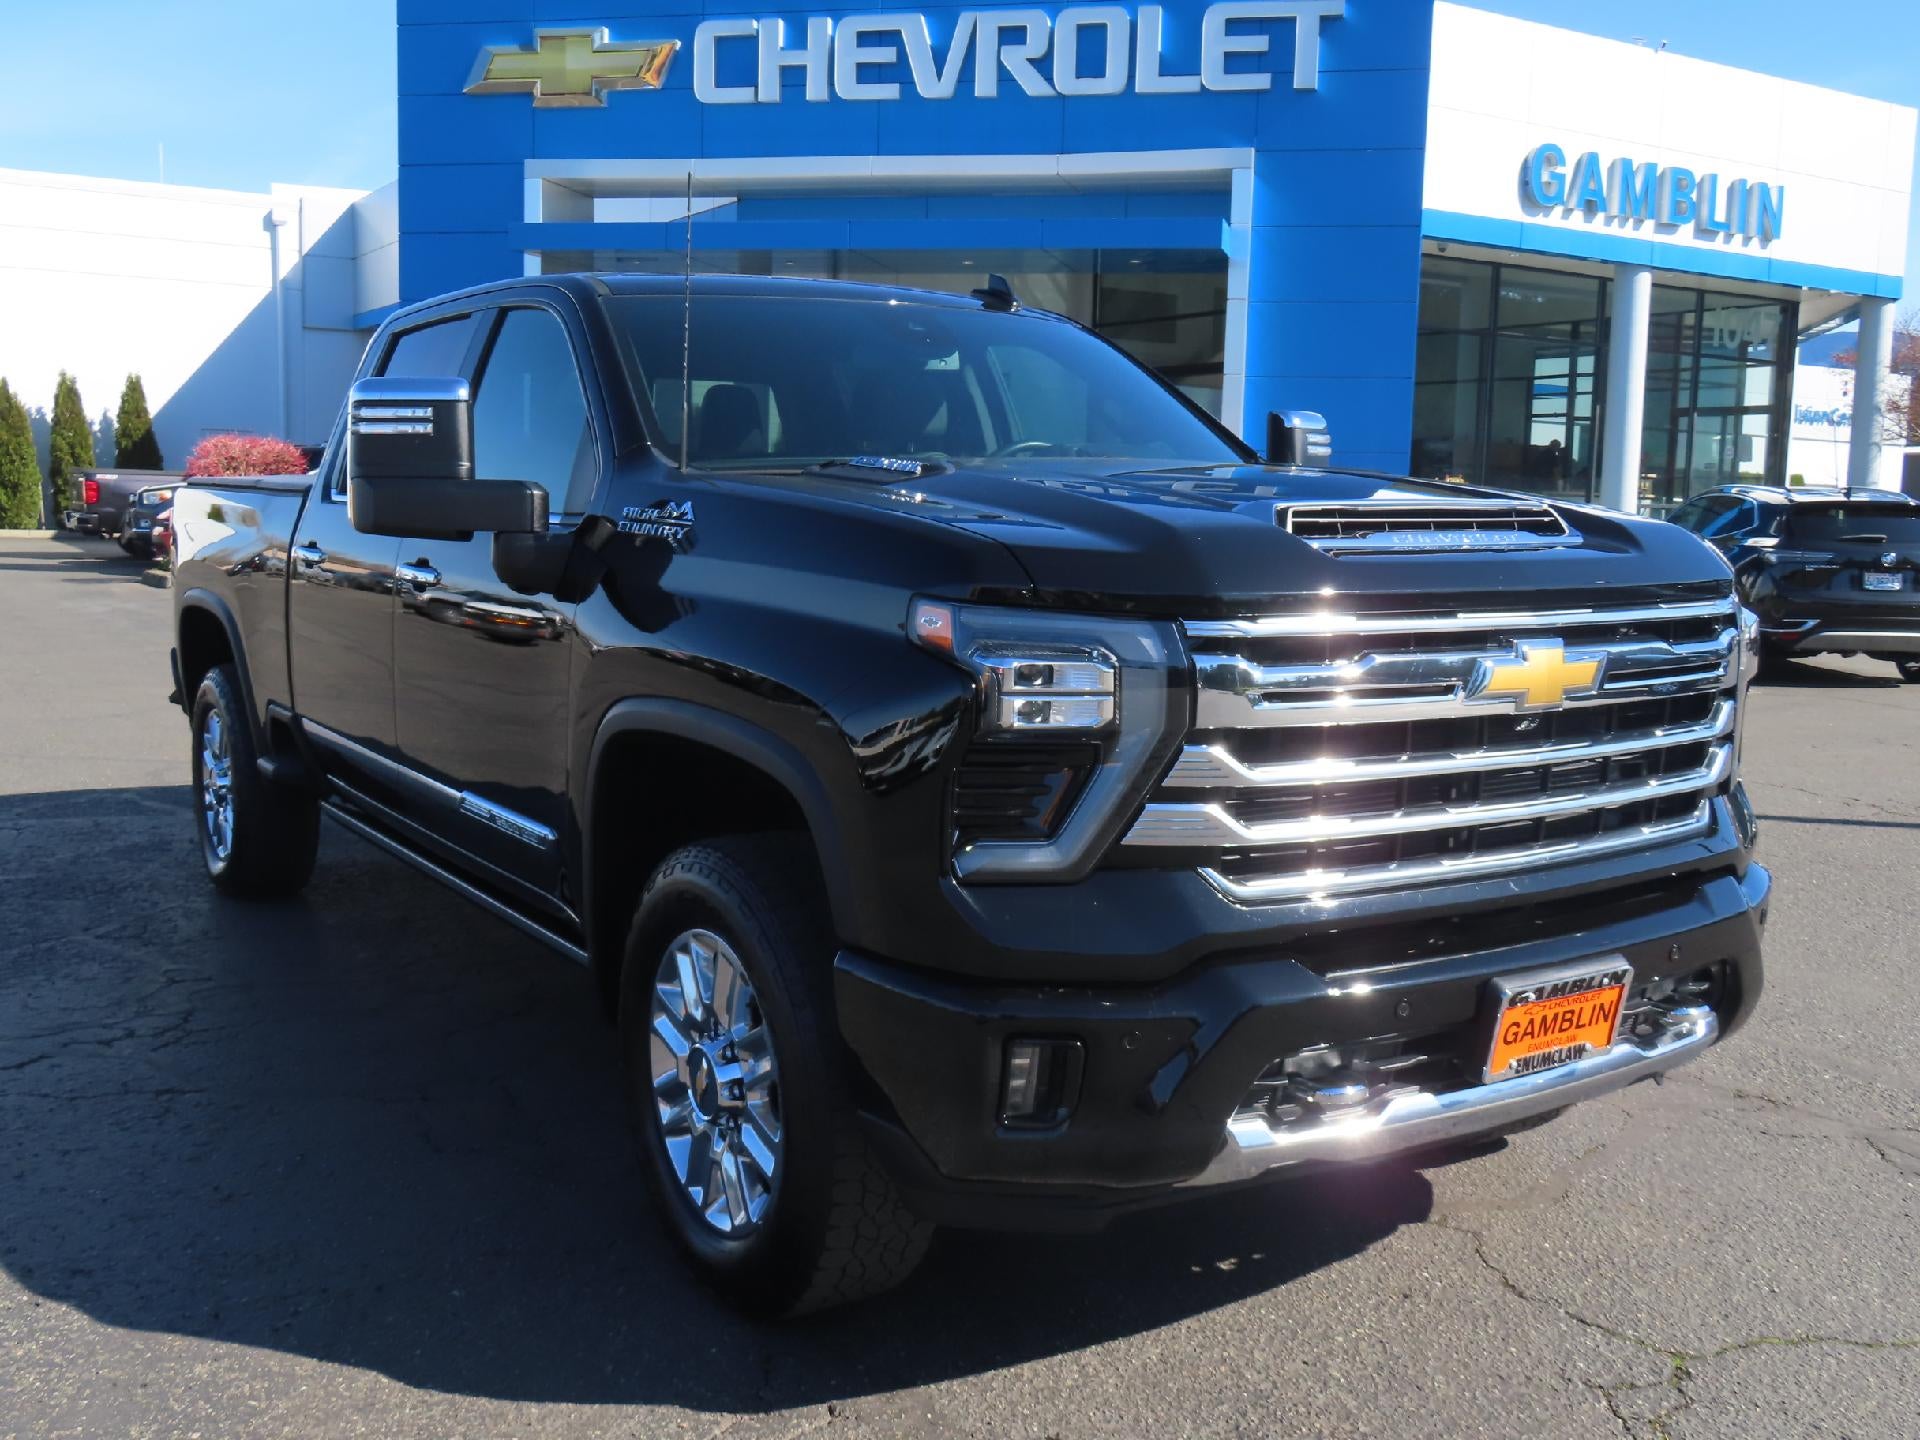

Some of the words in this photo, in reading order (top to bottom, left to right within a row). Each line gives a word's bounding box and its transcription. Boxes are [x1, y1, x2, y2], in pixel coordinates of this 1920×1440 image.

[692, 0, 1347, 104] CHEVROLET
[1522, 143, 1784, 242] GAMBLIN
[1548, 993, 1602, 1010] CHEVROLET
[1503, 1001, 1613, 1045] GAMBLIN
[1515, 1044, 1586, 1074] ENUMCLAW
[1527, 1033, 1579, 1052] ENUMCLAW
